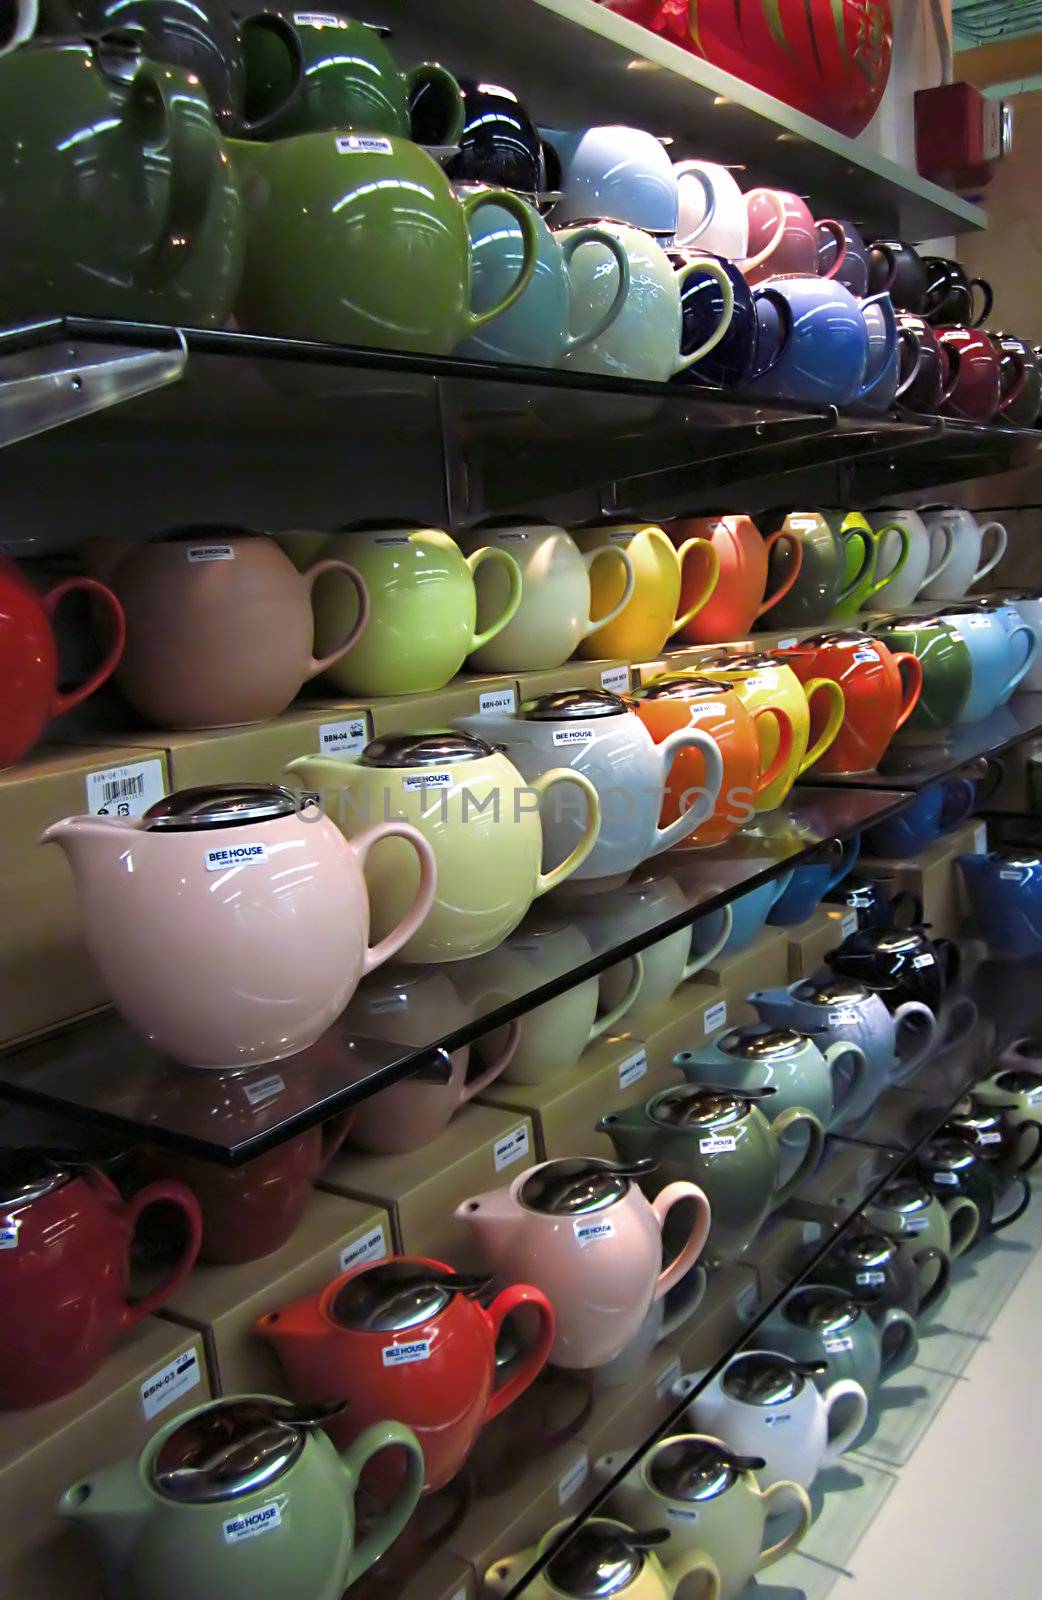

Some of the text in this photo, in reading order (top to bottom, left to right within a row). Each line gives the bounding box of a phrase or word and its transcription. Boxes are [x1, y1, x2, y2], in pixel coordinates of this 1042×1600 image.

[323, 732, 348, 743] BBN-04
[556, 732, 569, 740] BEE
[569, 730, 593, 738] HOUSE
[406, 776, 423, 785] BEE
[423, 774, 450, 783] HOUSE
[209, 846, 264, 862] BEE HOUSE
[385, 1348, 401, 1358] BEE
[400, 1343, 428, 1355] HOUSE
[143, 1371, 175, 1399] BBN-03
[226, 1519, 245, 1534] BEE
[245, 1507, 277, 1527] HOUSE
